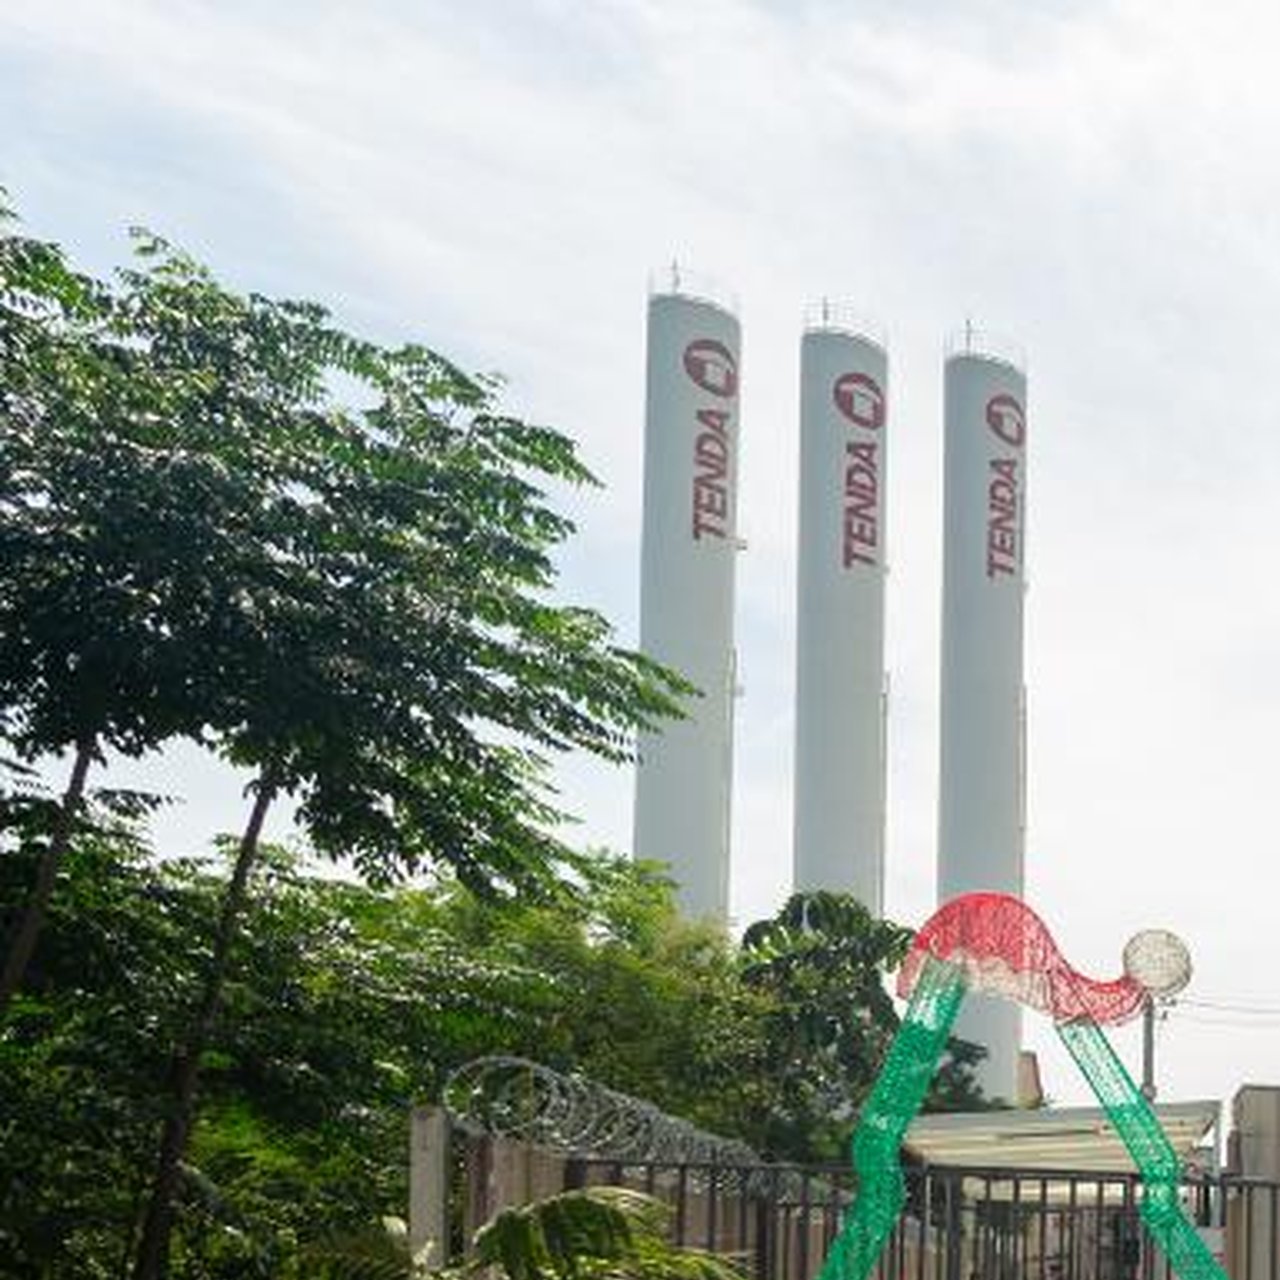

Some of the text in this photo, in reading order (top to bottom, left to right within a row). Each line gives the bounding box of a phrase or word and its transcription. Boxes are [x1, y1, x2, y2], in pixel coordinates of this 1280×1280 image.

[692, 408, 730, 541] TENDA
[843, 440, 880, 571] TENDA
[986, 458, 1019, 580] TENDA
